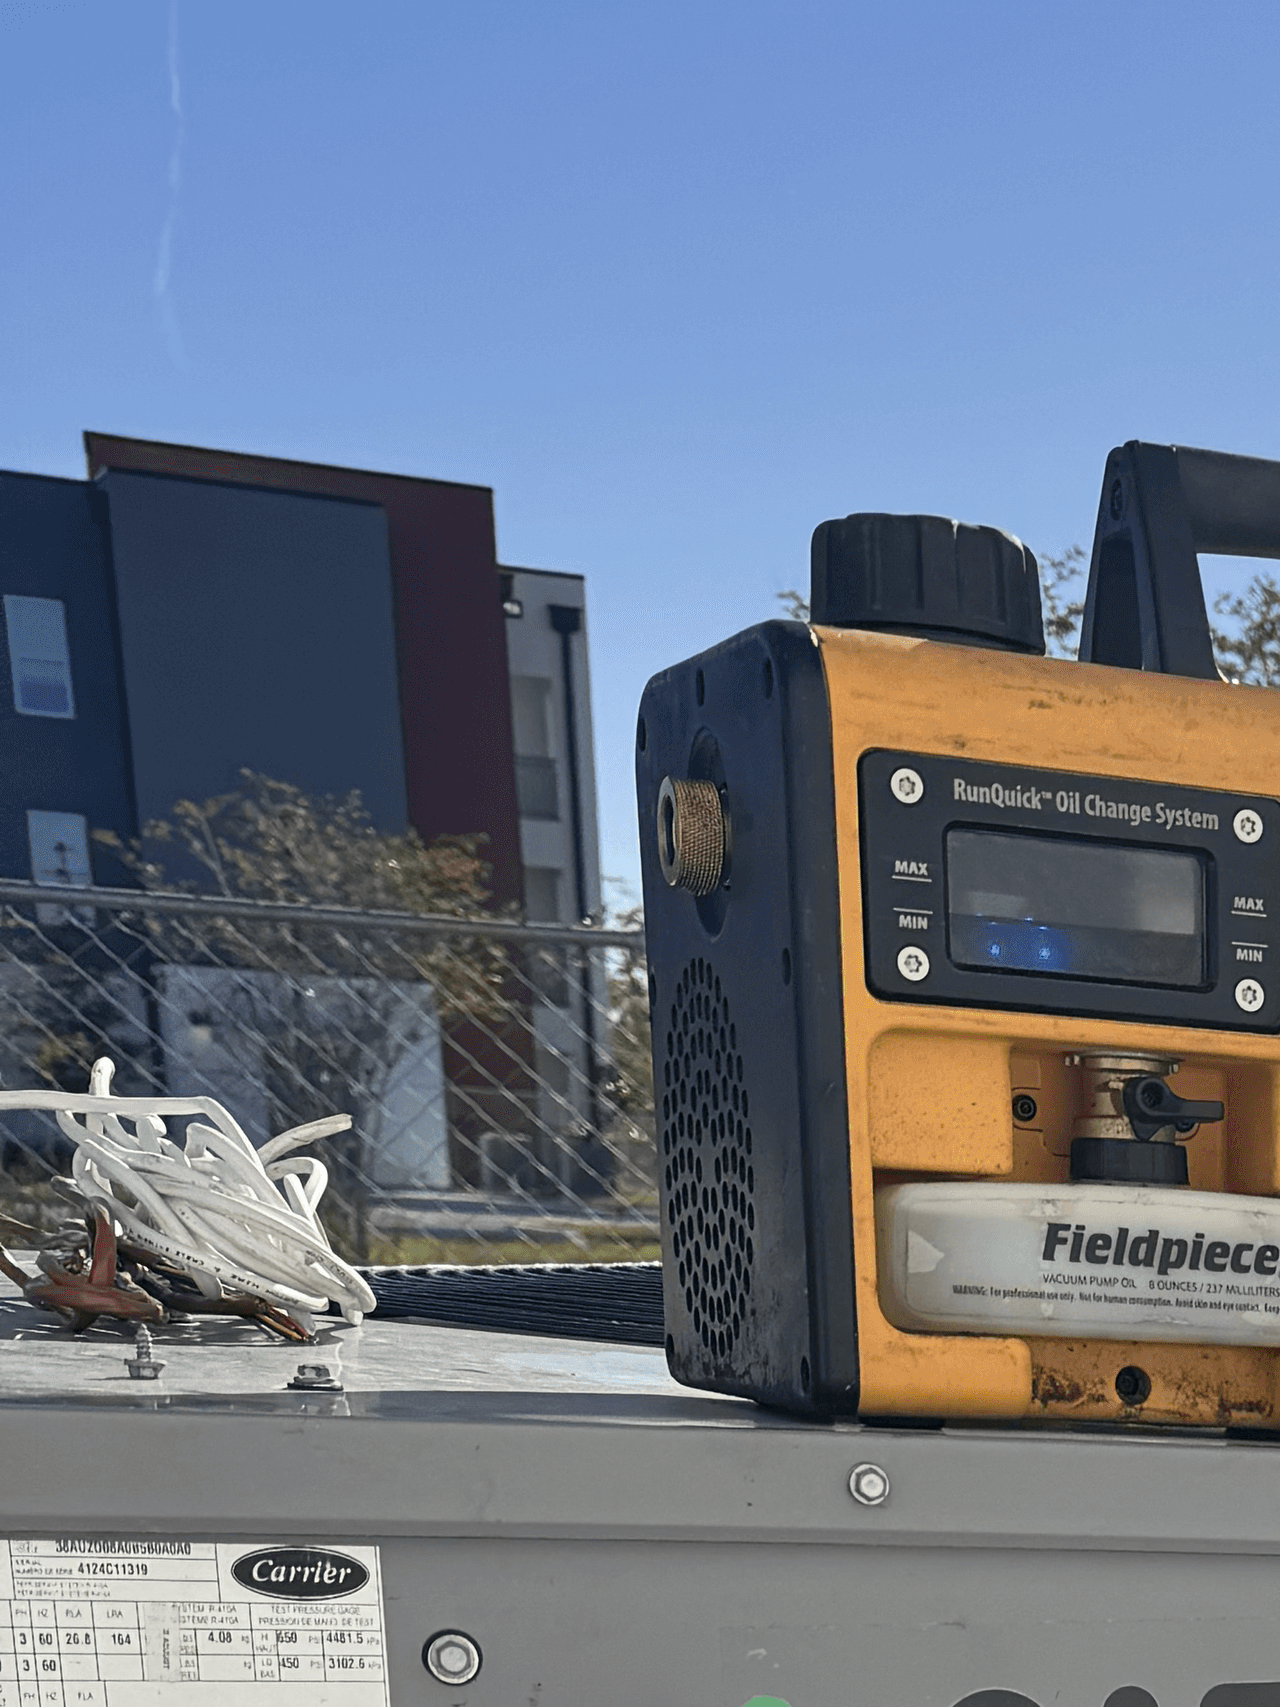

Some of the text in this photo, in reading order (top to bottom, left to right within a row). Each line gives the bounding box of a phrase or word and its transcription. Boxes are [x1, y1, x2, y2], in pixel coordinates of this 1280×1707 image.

[1055, 794, 1080, 814] Oil
[1084, 796, 1151, 827] Change
[1155, 803, 1219, 831] System
[894, 860, 929, 877] MAX
[1233, 897, 1264, 912] MAX
[898, 915, 929, 931] MIN
[1235, 948, 1263, 963] MIN
[1042, 1222, 1280, 1276] Fieldpiece
[1042, 1274, 1087, 1286] VACUUM
[1089, 1275, 1119, 1288] PUMP
[1121, 1277, 1137, 1289] OIL
[1157, 1281, 1197, 1293] OUNCES
[1206, 1283, 1223, 1294] 237
[1226, 1285, 1280, 1298] MILLILITERS
[252, 1559, 352, 1584] Carrier
